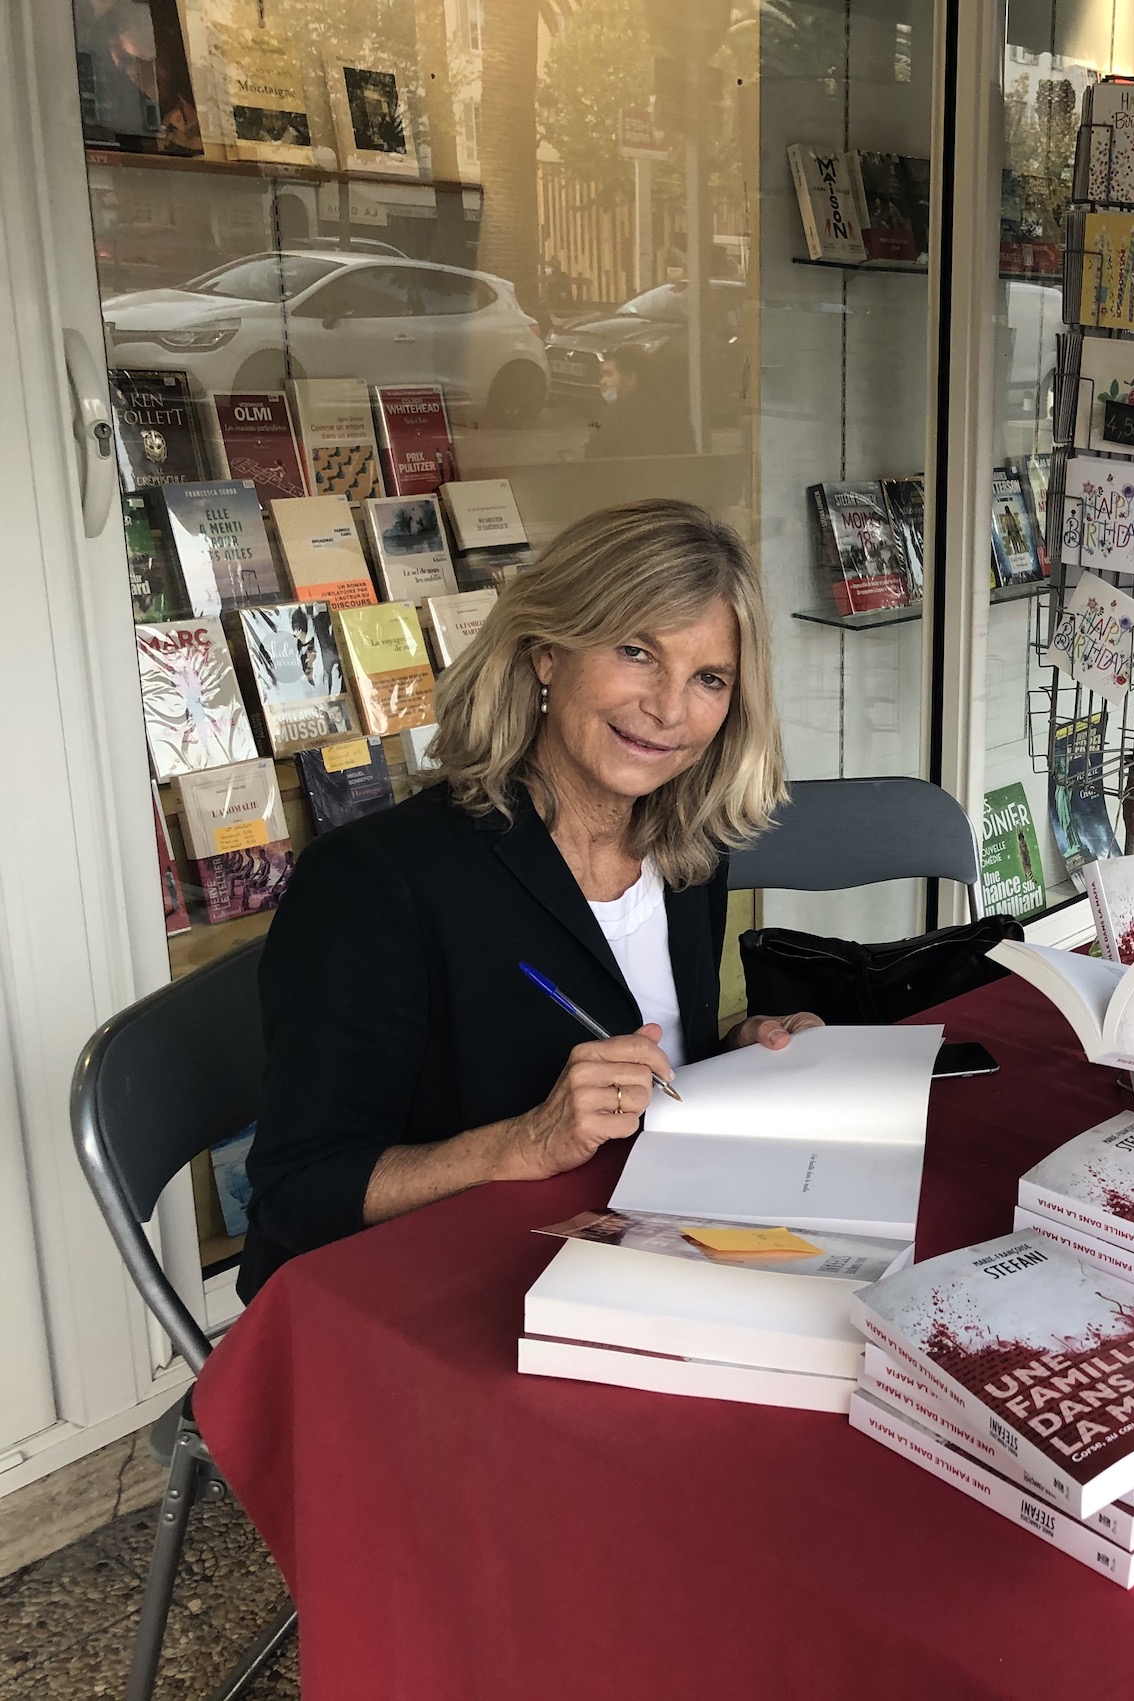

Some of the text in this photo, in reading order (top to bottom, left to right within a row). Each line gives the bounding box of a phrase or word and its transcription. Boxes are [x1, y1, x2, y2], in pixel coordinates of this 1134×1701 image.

[237, 79, 297, 100] Montaigne
[131, 393, 163, 408] KEN
[116, 408, 183, 425] FOLLETT
[234, 407, 272, 421] OLMI
[387, 404, 440, 415] WHITEHEAD
[311, 424, 335, 432] Comme
[406, 452, 424, 462] PRIX
[400, 461, 436, 473] PULITZER
[1084, 492, 1132, 520] HAPPY
[206, 509, 230, 521] ELLE
[210, 521, 243, 534] MENTI
[332, 599, 372, 610] DISCOURS
[1079, 610, 1128, 645] HAPPY
[138, 628, 211, 654] MARC
[371, 639, 380, 647] La
[276, 719, 328, 744] MUSSO
[348, 775, 374, 785] BONNEFOY
[983, 801, 1030, 840] DINIER
[982, 841, 1006, 856] OUVELLE
[982, 854, 1002, 868] OMÉDIE
[983, 871, 1000, 887] Une
[983, 875, 1035, 906] hance sur
[1091, 881, 1100, 907] MAFIA
[221, 896, 231, 909] LE
[996, 885, 1043, 917] Milliard
[1037, 1198, 1064, 1214] MAFIA
[1065, 1209, 1077, 1219] LA
[1078, 1214, 1102, 1228] DANS
[1032, 1225, 1058, 1241] MAFIA
[1060, 1236, 1071, 1246] LA
[972, 1243, 1032, 1267] MARIE-FRANÇOISE
[1073, 1242, 1096, 1256] DANS
[983, 1250, 1049, 1280] STEFANI
[1097, 1251, 1132, 1272] FAMILLE
[865, 1320, 965, 1408] UNE FAMILLE DANS LA MAFIA
[886, 1367, 928, 1393] LA MAFIA
[983, 1352, 1072, 1399] UNE
[876, 1380, 995, 1456] UNE FAMILLE DANS LA MAFIA
[990, 1417, 1018, 1451] STEFANI
[1051, 1418, 1112, 1457] LA
[869, 1418, 991, 1495] UNE FAMILLE DANS LA MAFIA
[1071, 1440, 1107, 1464] Corse,
[1105, 1433, 1118, 1446] au
[1021, 1500, 1055, 1530] STEFANI
